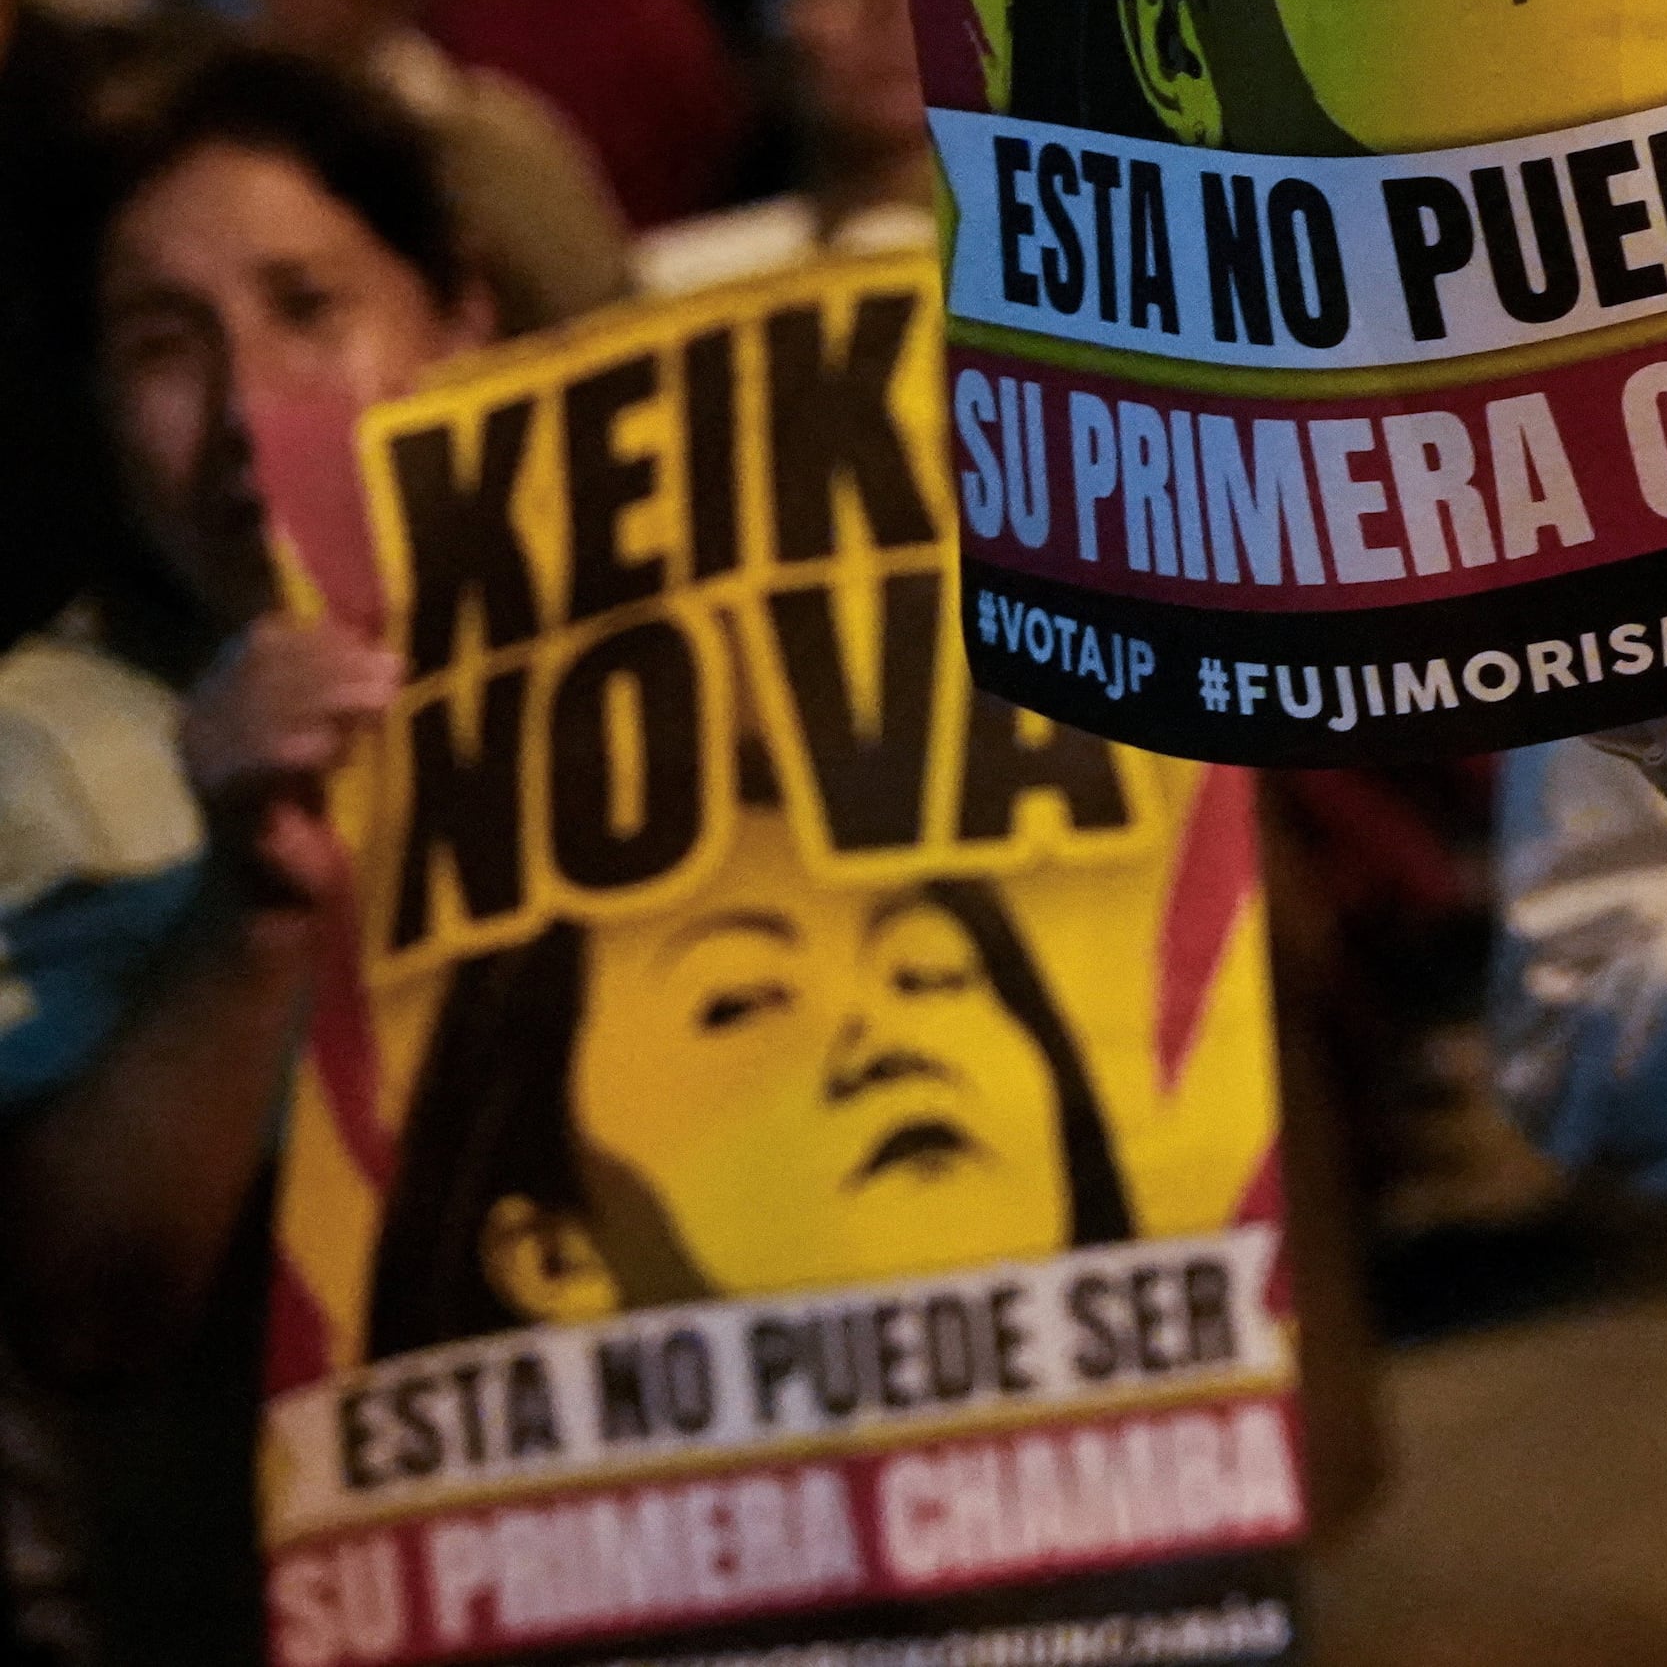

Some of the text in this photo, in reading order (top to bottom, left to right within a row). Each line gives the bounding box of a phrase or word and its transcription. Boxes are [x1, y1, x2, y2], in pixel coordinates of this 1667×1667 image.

[993, 133, 1180, 336] ESTA
[1204, 161, 1350, 351] NO
[954, 367, 1050, 549] SU
[1070, 386, 1595, 587] PRIMERA
[978, 589, 1156, 697] #VOTAJP
[338, 1257, 1241, 1490] ESTA NO PUEDE SER
[269, 1535, 401, 1665] SU
[428, 1465, 865, 1651] PRIMERA
